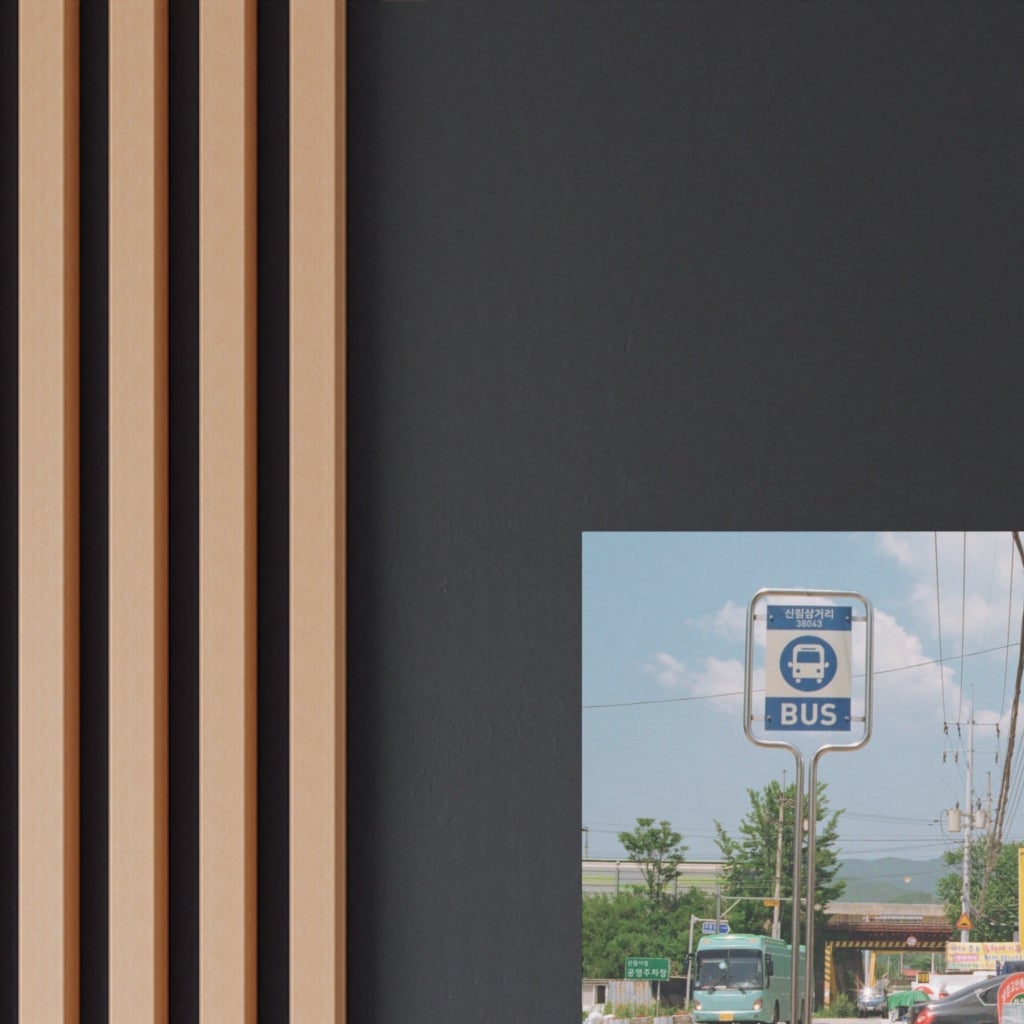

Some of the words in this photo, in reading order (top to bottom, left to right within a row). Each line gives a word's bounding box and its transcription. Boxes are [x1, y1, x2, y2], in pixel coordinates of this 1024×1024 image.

[785, 608, 834, 620] 신림삼거리
[796, 619, 823, 628] 38043
[781, 703, 837, 726] BUS
